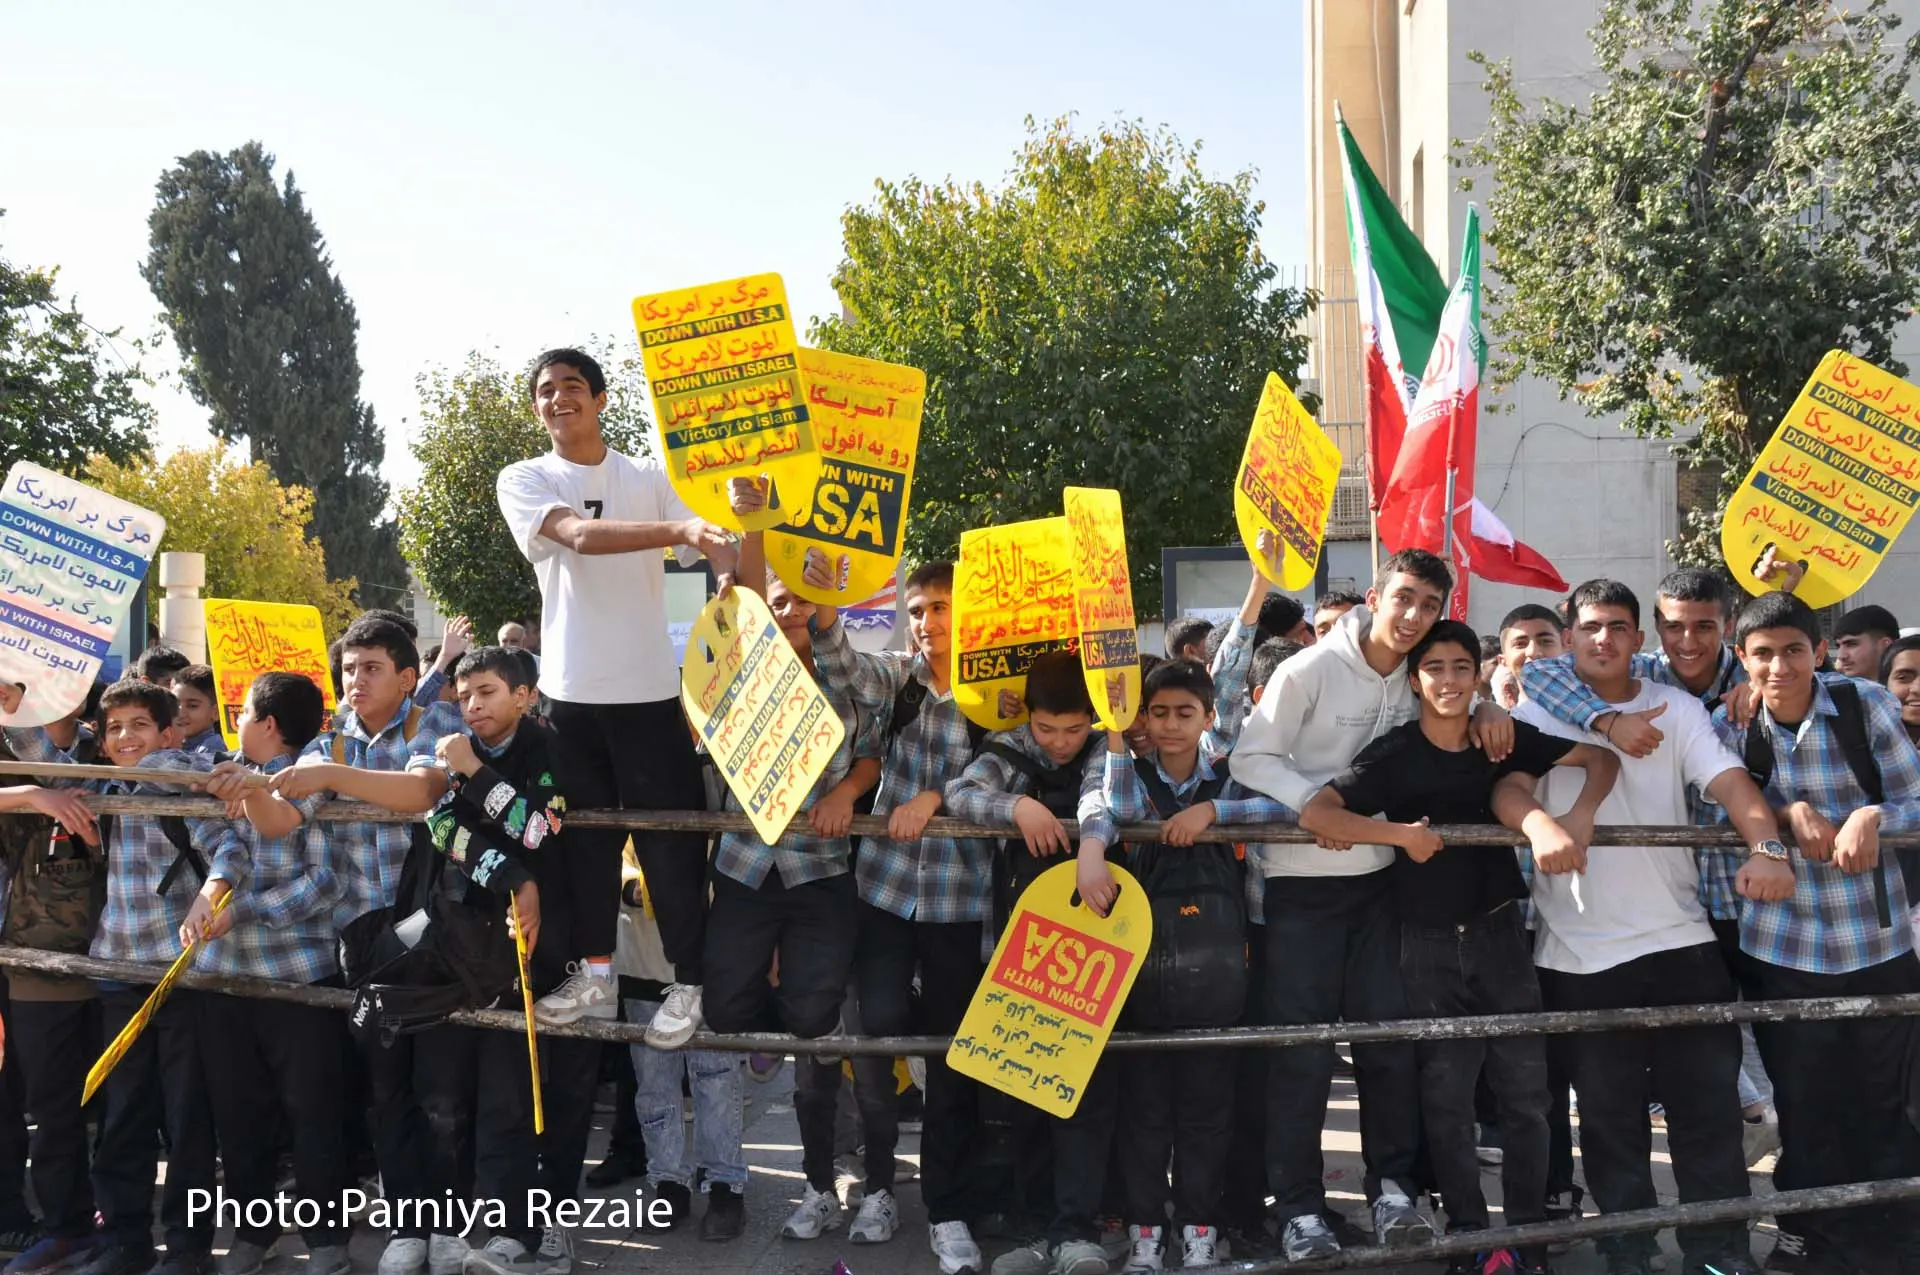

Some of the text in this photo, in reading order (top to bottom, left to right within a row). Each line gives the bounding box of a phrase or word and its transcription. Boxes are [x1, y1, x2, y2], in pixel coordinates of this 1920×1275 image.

[708, 295, 724, 315] بر
[730, 280, 768, 307] مرگ
[645, 307, 781, 345] DOWN WITH U.S.A
[726, 328, 779, 359] الموت
[655, 356, 794, 396] DOWN WITH ISRAEL
[744, 377, 795, 408] الموت
[809, 384, 898, 419] آمریکا
[1815, 384, 1862, 418] DOWN
[1864, 408, 1904, 437] WITH
[1885, 403, 1911, 422] بر
[677, 410, 797, 445] Victory to Islam
[822, 425, 864, 454] افول
[868, 438, 884, 462] به
[1784, 428, 1914, 505] DOWN WITH ISRAEL
[820, 463, 894, 493] WN WITH
[584, 499, 604, 519] 7
[1244, 473, 1272, 520] USA
[1764, 478, 1876, 546] Victory to Islam
[1844, 492, 1899, 528] الموت
[76, 511, 99, 528] بر
[106, 515, 151, 544] مرگ
[2, 510, 136, 573] DOWN WITH U.S.A
[0, 534, 127, 595] الموت لامريك
[44, 597, 65, 612] بر
[71, 599, 113, 625] مرگ
[12, 611, 47, 633] WITH
[49, 626, 98, 653] ISRAEL
[33, 643, 88, 675] الموت
[963, 647, 1011, 661] DOWN WITH
[963, 656, 1011, 681] USA
[1085, 641, 1107, 667] USA
[710, 634, 770, 728] Victory to Islam
[719, 707, 745, 755] الموت
[728, 662, 799, 774] DOWN WITH ISRAEL
[796, 699, 823, 742] DOWN
[743, 740, 770, 790] الموت
[774, 742, 798, 775] WITH
[765, 788, 788, 821] مرگ
[783, 762, 795, 788] بر
[1022, 920, 1116, 1001] USA
[1003, 967, 1099, 1017] DOWN WITH
[1005, 1000, 1036, 1022] قابل
[1062, 1027, 1094, 1047] است
